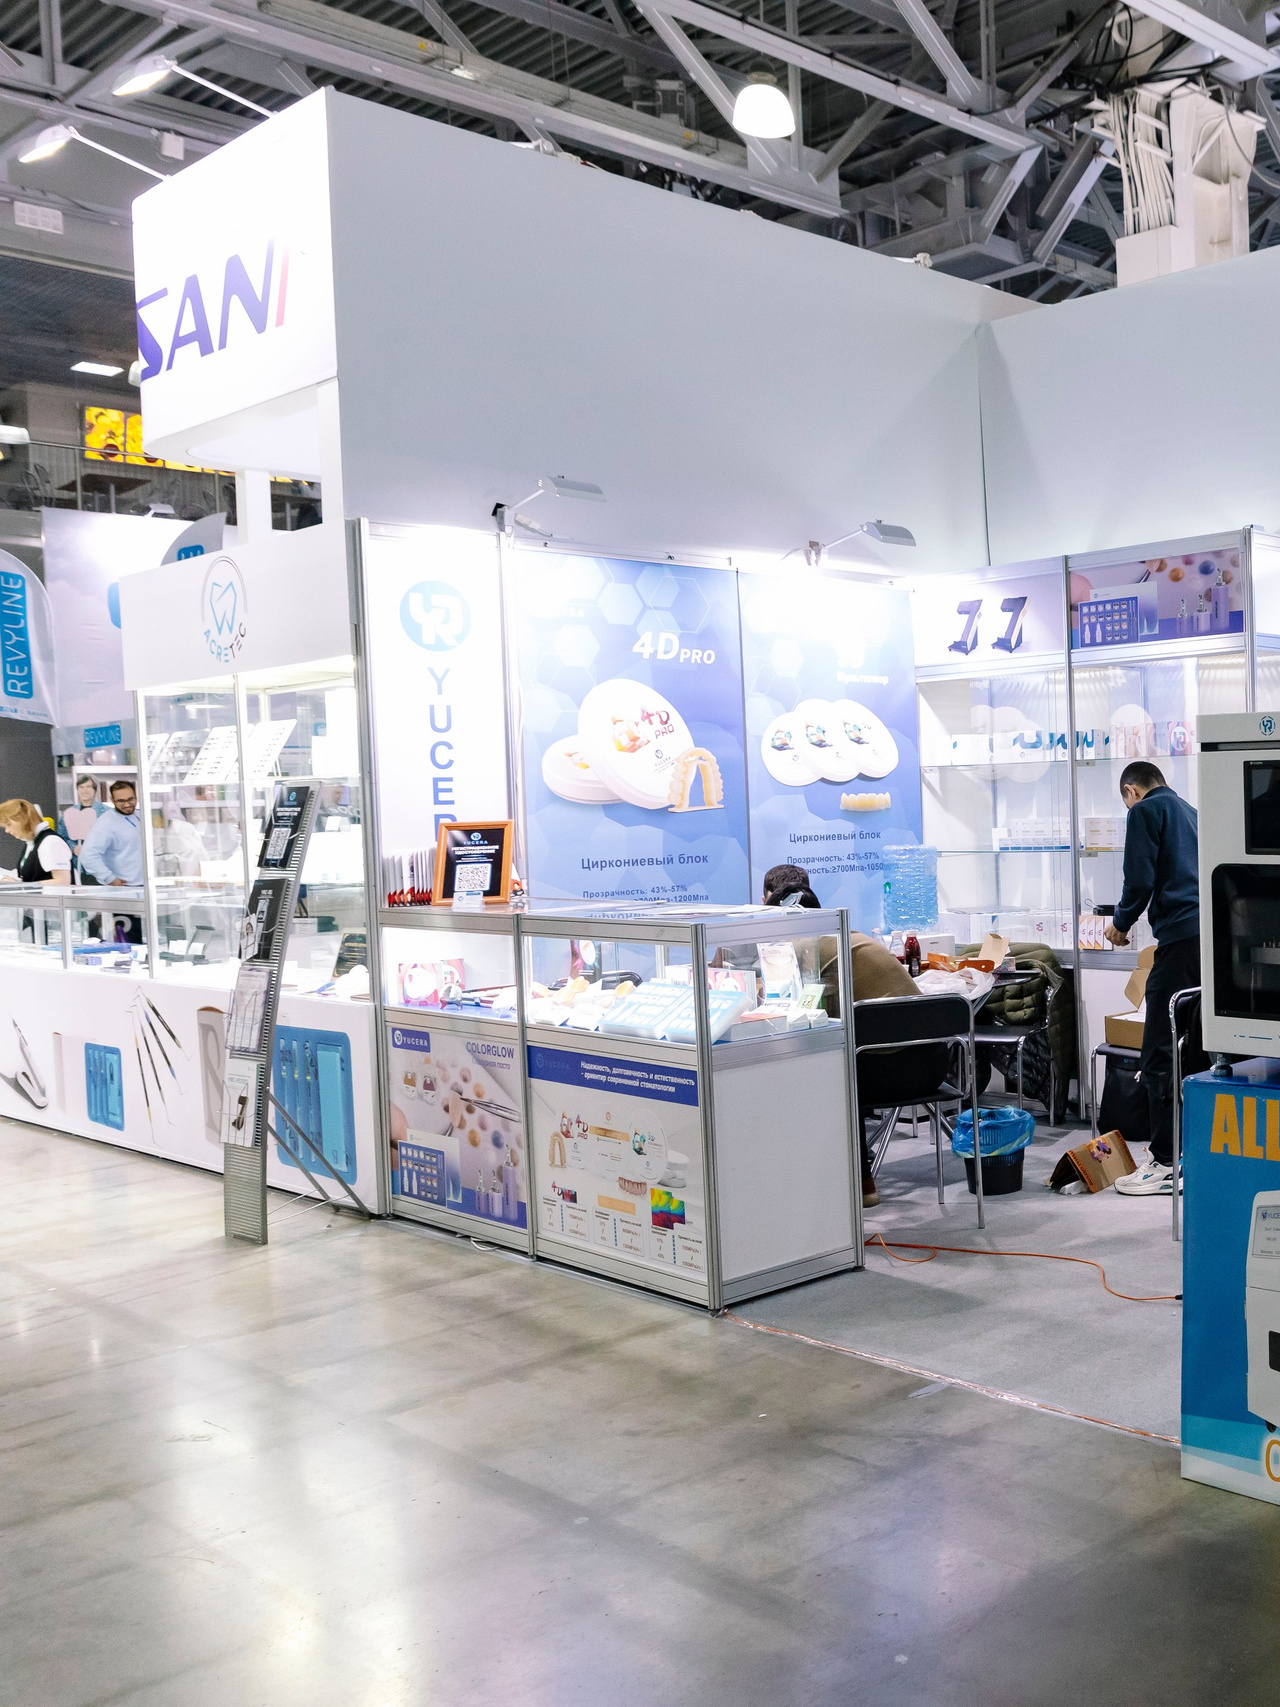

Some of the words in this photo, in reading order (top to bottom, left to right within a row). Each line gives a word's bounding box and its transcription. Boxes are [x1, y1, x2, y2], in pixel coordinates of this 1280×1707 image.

[1, 573, 29, 696] REVYLINE
[204, 622, 247, 663] ACRETEC
[85, 726, 121, 746] REVYLINE
[789, 831, 857, 844] Циркониевый
[859, 830, 881, 840] блок
[580, 853, 674, 871] Циркониевый
[678, 853, 709, 866] блок
[786, 854, 845, 865] Прозрачность:
[846, 852, 880, 861] 43%-57%
[582, 887, 648, 900] Прозрачность:
[650, 884, 688, 894] 43%-57%
[403, 1036, 429, 1047] YUCERA
[466, 1041, 515, 1059] COLORGLOW
[581, 1060, 611, 1074] Надежность,
[654, 1074, 696, 1086] естественность
[577, 1132, 588, 1140] PRO
